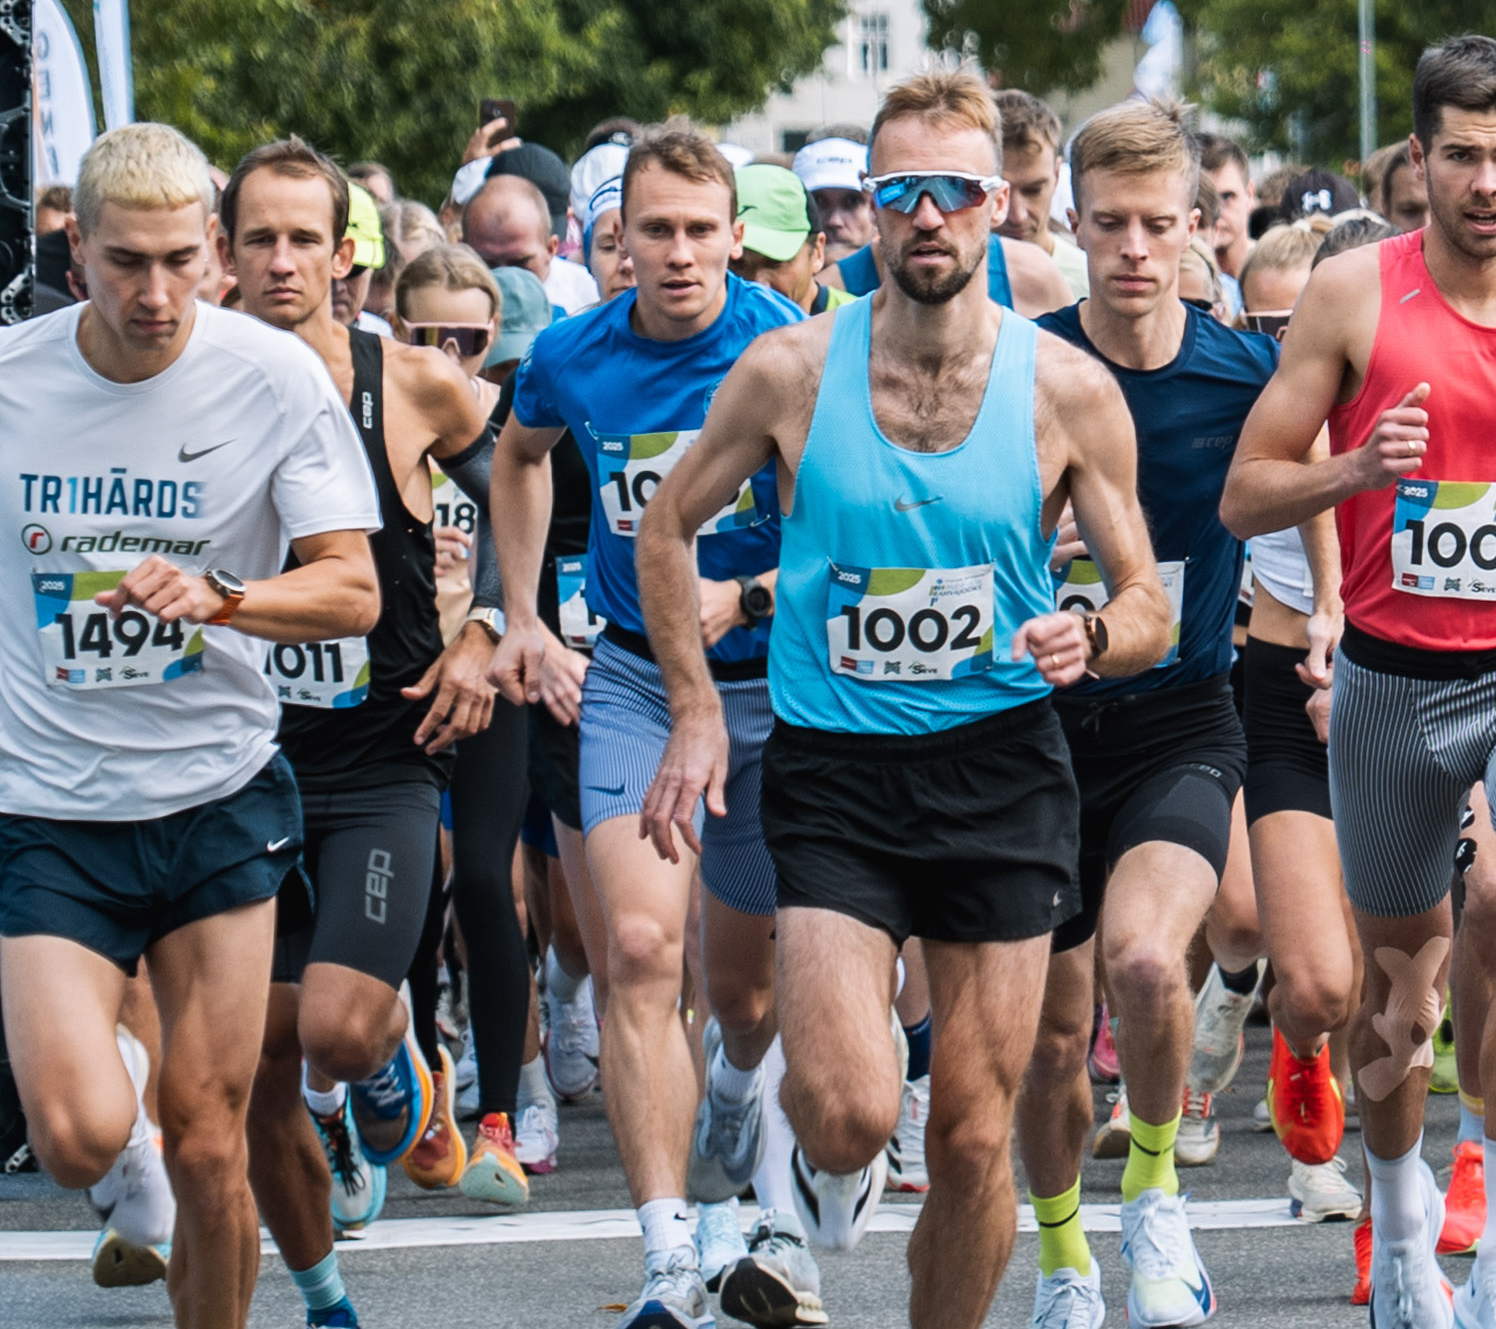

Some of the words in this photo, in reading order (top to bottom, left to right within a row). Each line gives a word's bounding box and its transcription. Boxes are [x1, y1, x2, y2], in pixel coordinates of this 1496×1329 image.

[1404, 486, 1428, 498] 2025
[435, 502, 478, 536] 18
[60, 530, 212, 557] rademar
[837, 570, 862, 585] 2025
[55, 610, 185, 660] 1494
[840, 604, 982, 653] 1002
[365, 847, 396, 925] cep
